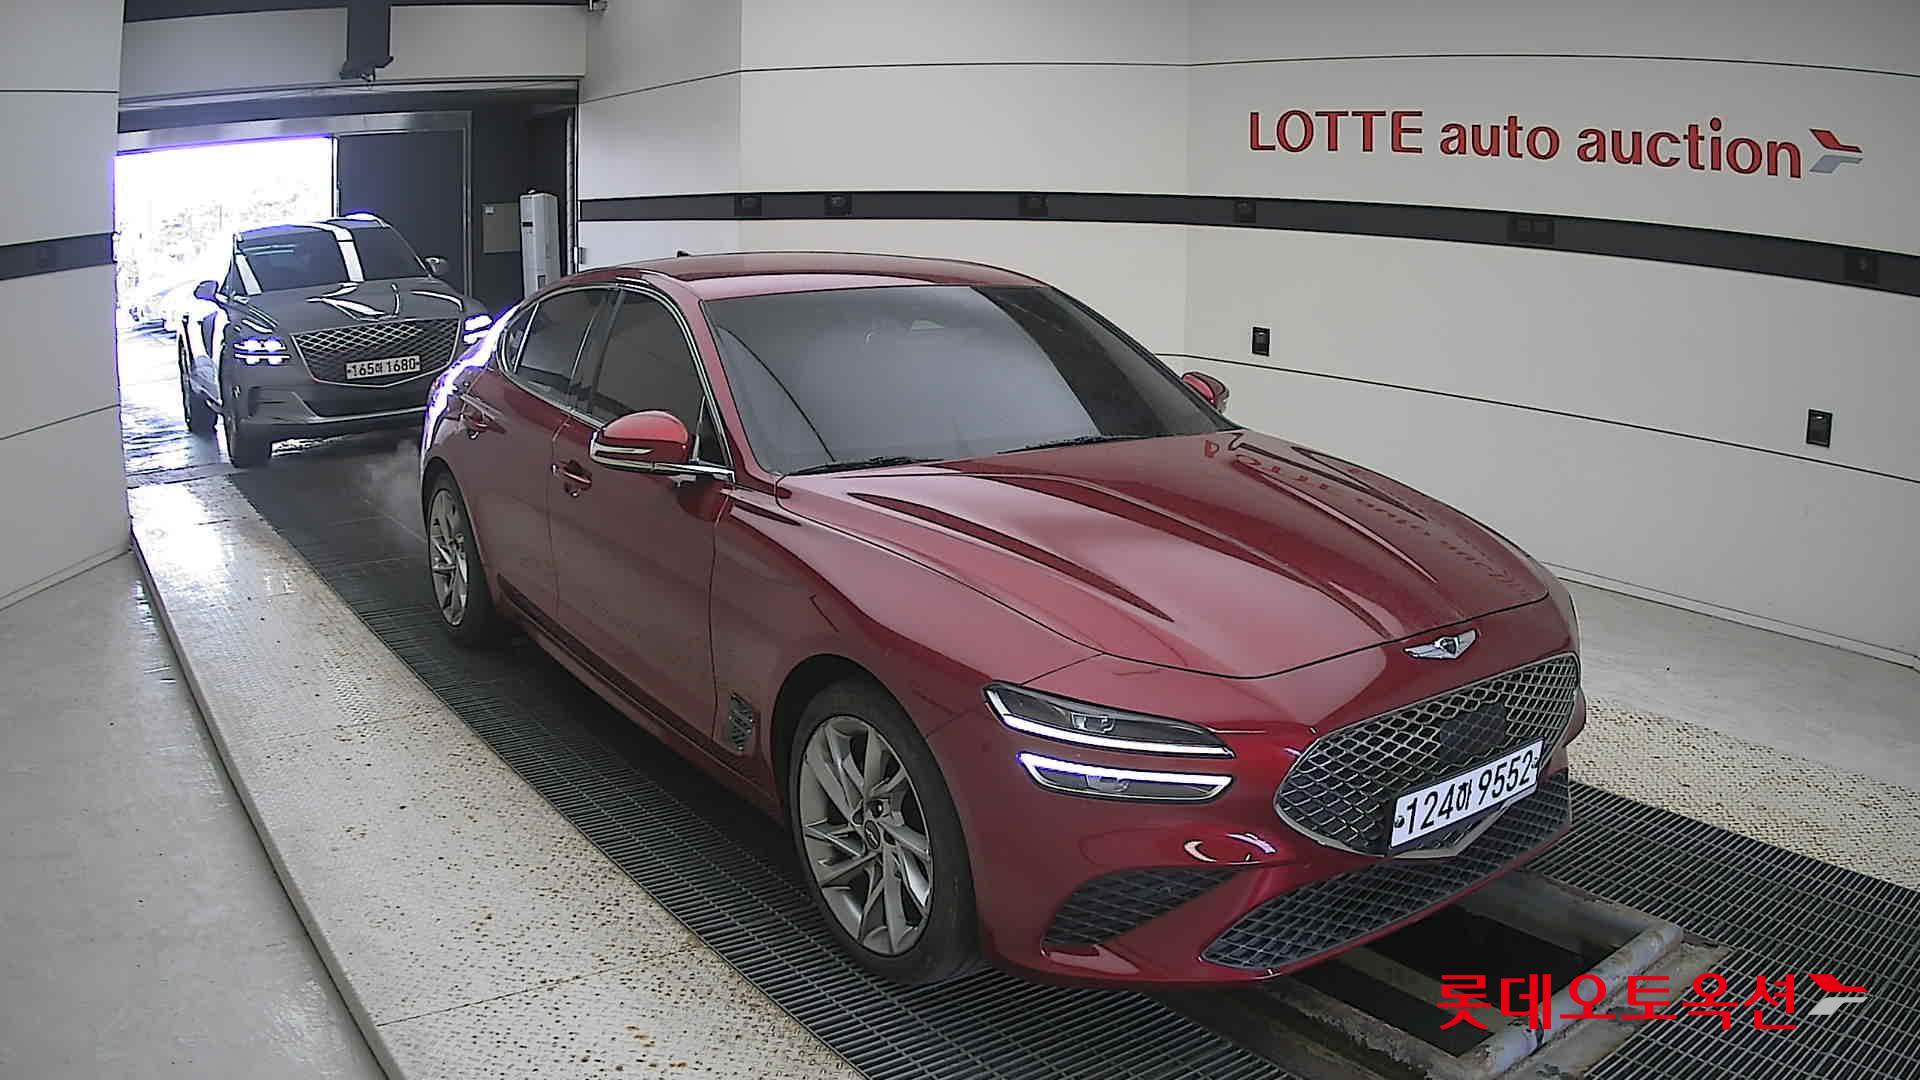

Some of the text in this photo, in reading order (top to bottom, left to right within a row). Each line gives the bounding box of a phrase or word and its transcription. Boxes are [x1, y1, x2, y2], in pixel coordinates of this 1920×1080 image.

[1250, 110, 1802, 178] LOTTE auto auction
[386, 358, 416, 373] 1680
[1478, 750, 1533, 805] 9552
